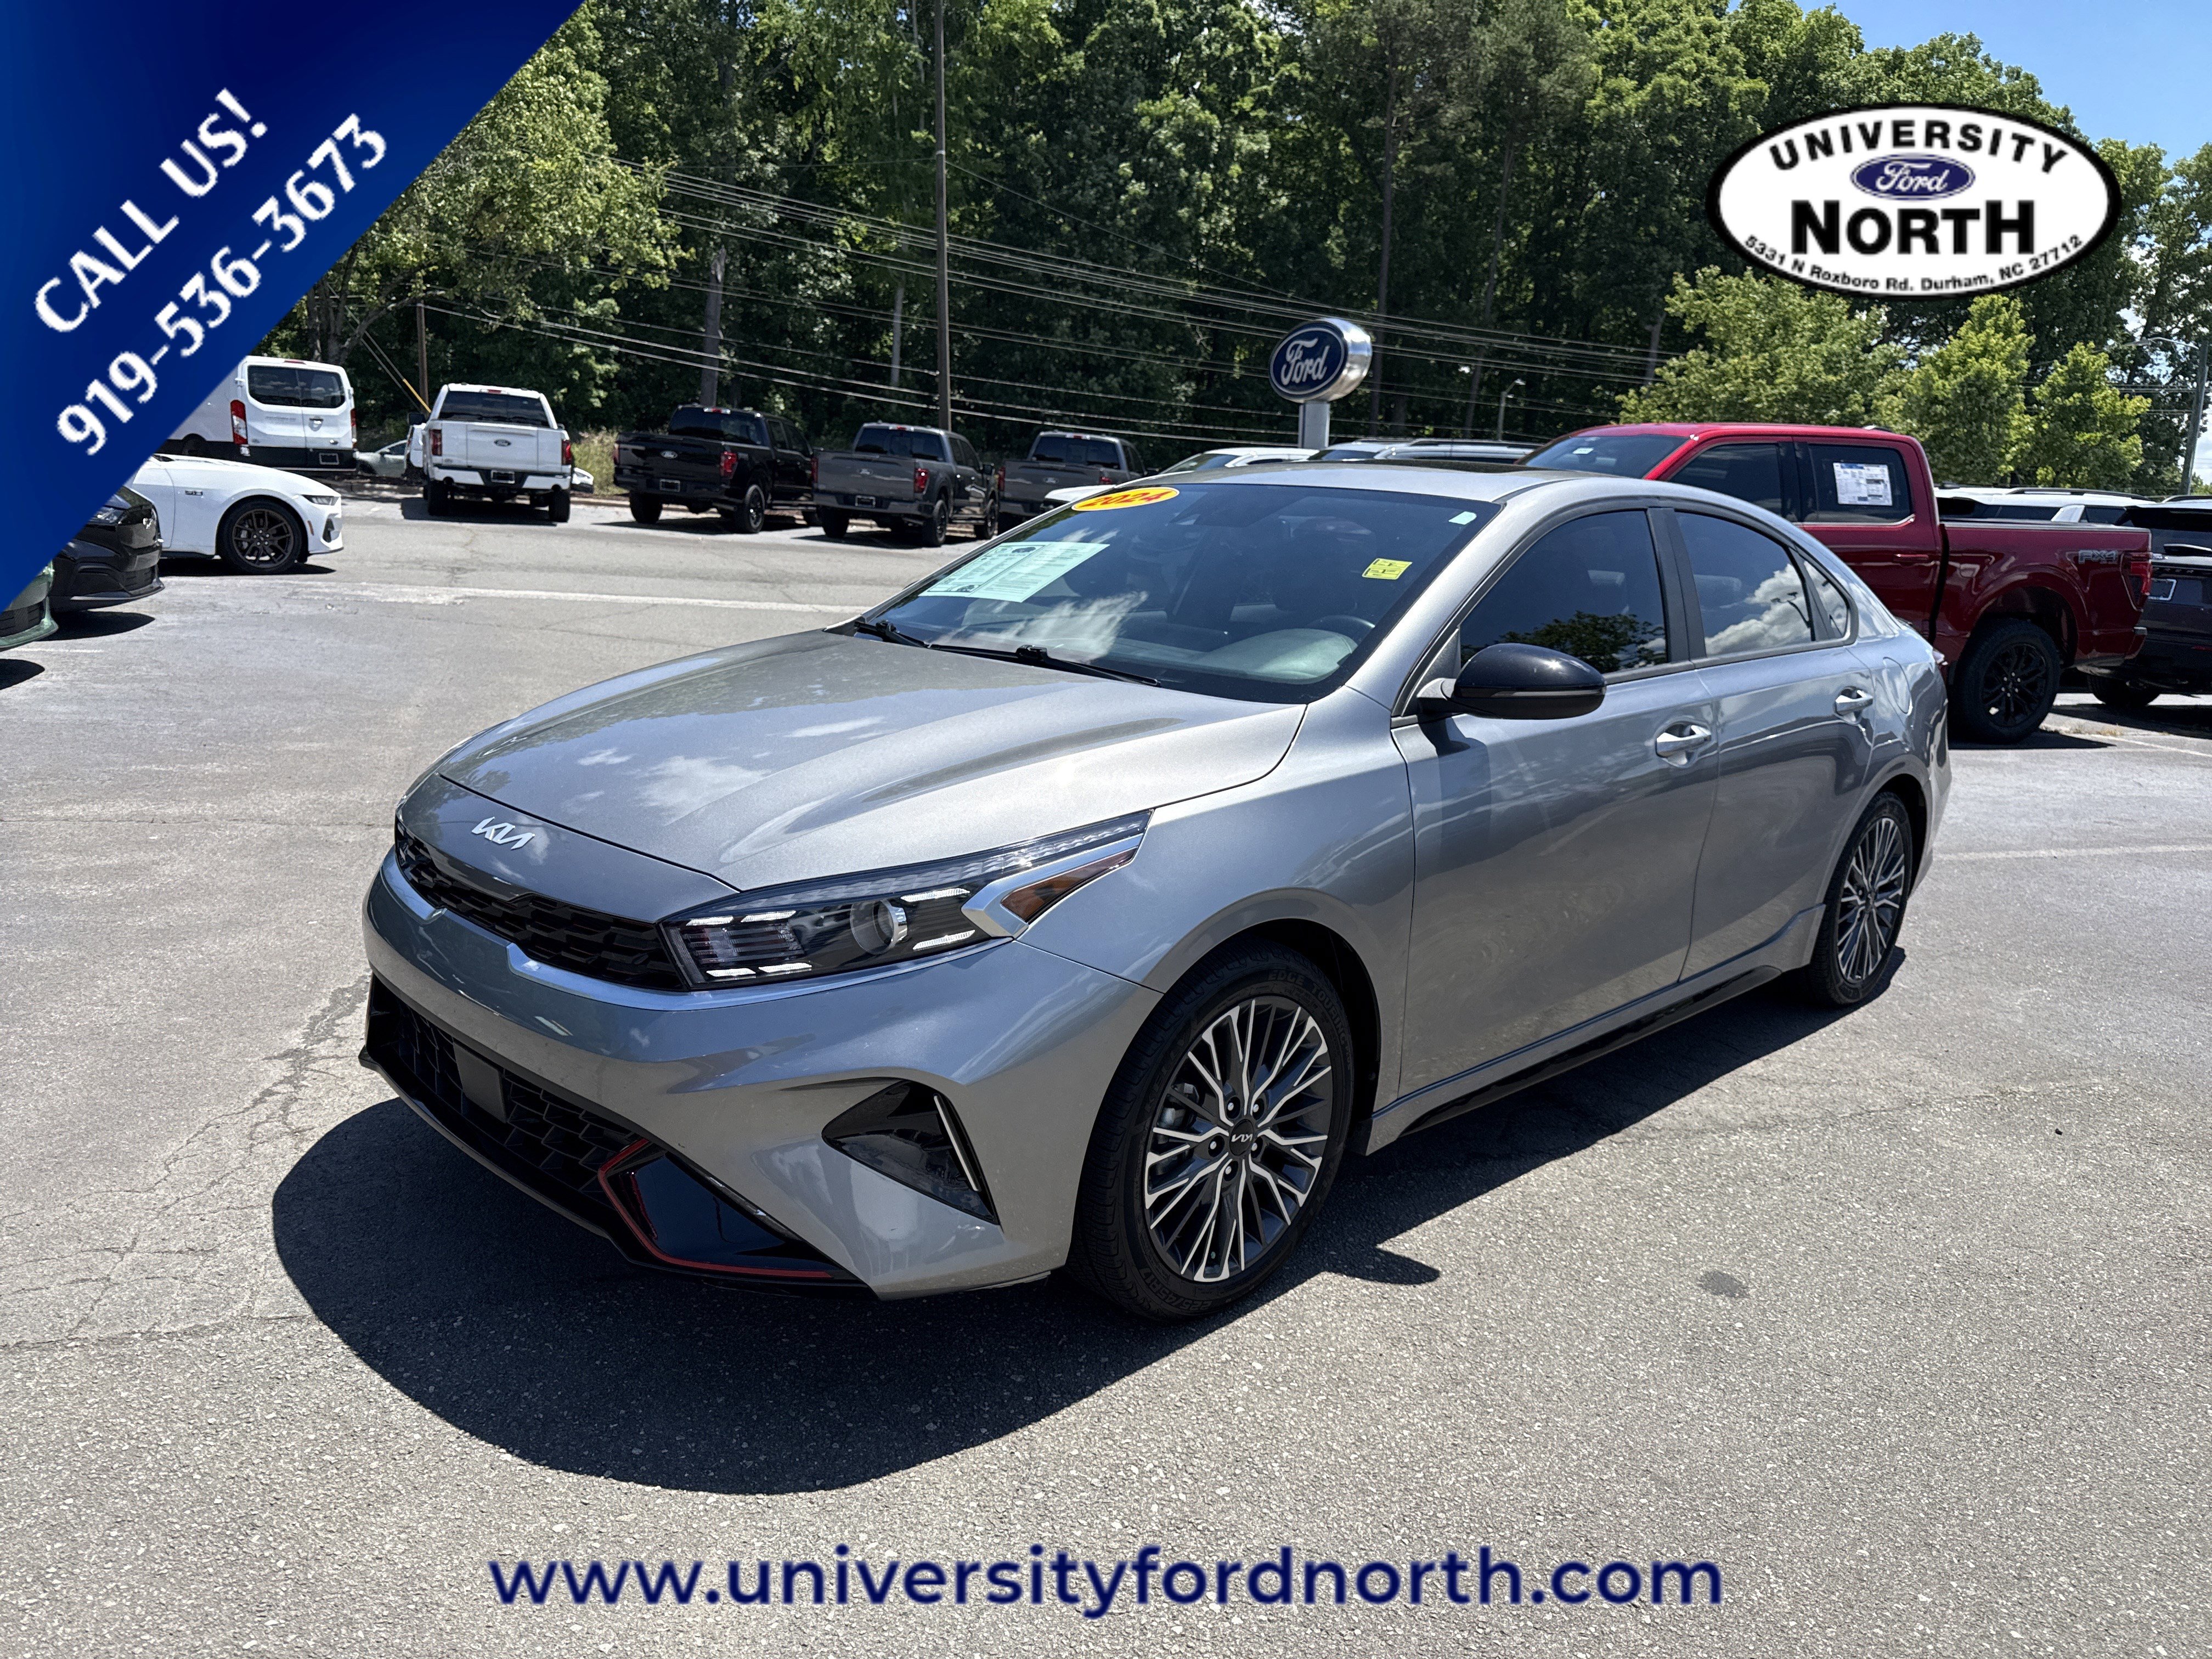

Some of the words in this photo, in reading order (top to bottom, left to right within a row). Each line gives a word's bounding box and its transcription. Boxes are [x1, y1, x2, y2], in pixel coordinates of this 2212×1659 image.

[1280, 337, 1330, 386] Ford
[1078, 490, 1173, 508] 2024
[2078, 550, 2118, 565] FX4
[471, 816, 536, 850] KIA
[1267, 968, 1306, 987] EDGE
[1311, 982, 1348, 1048] TOURING
